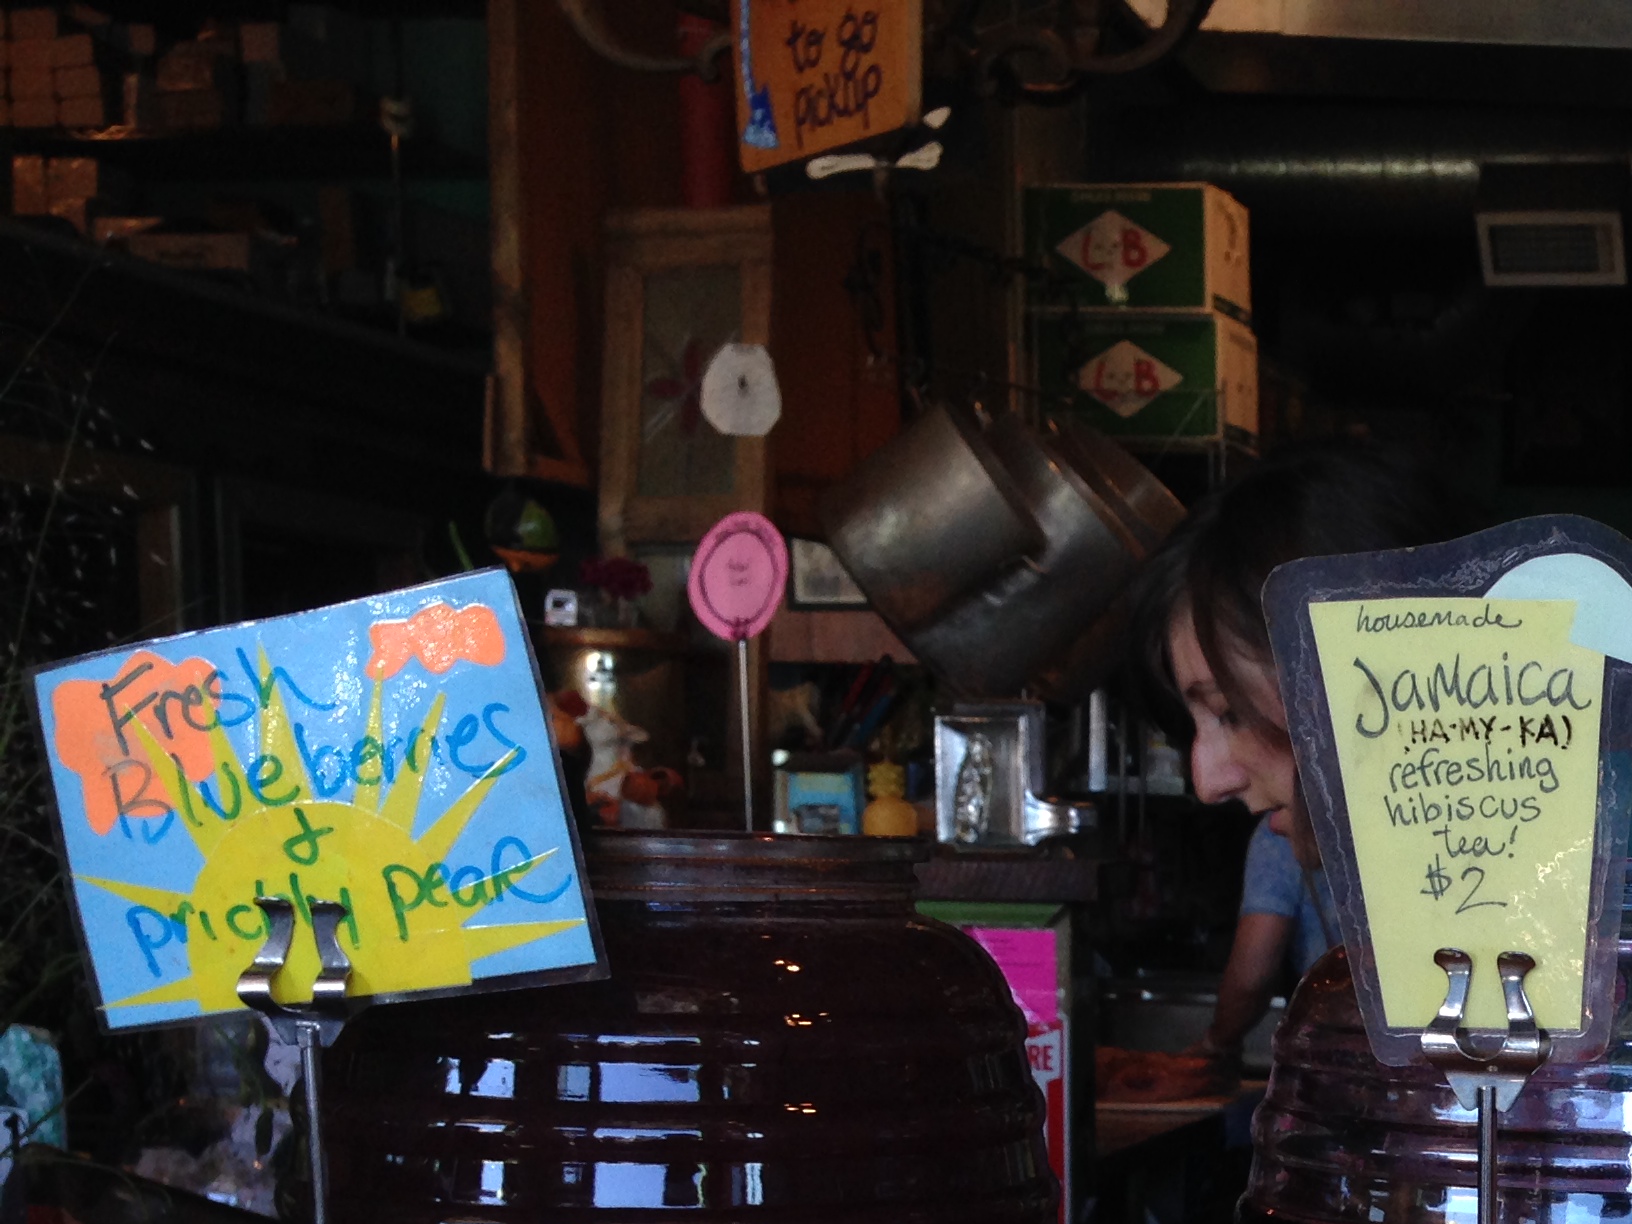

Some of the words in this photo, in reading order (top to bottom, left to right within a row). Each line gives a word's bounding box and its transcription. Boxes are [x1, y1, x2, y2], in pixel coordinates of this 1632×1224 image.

[837, 8, 880, 80] go
[1356, 603, 1523, 634] housemade
[101, 646, 336, 756] Fresh
[106, 702, 528, 845] Blueberries
[1388, 739, 1560, 794] refreshing
[1383, 795, 1542, 828] hibiscus
[1433, 825, 1520, 859] tea!
[1420, 854, 1508, 916] $2
